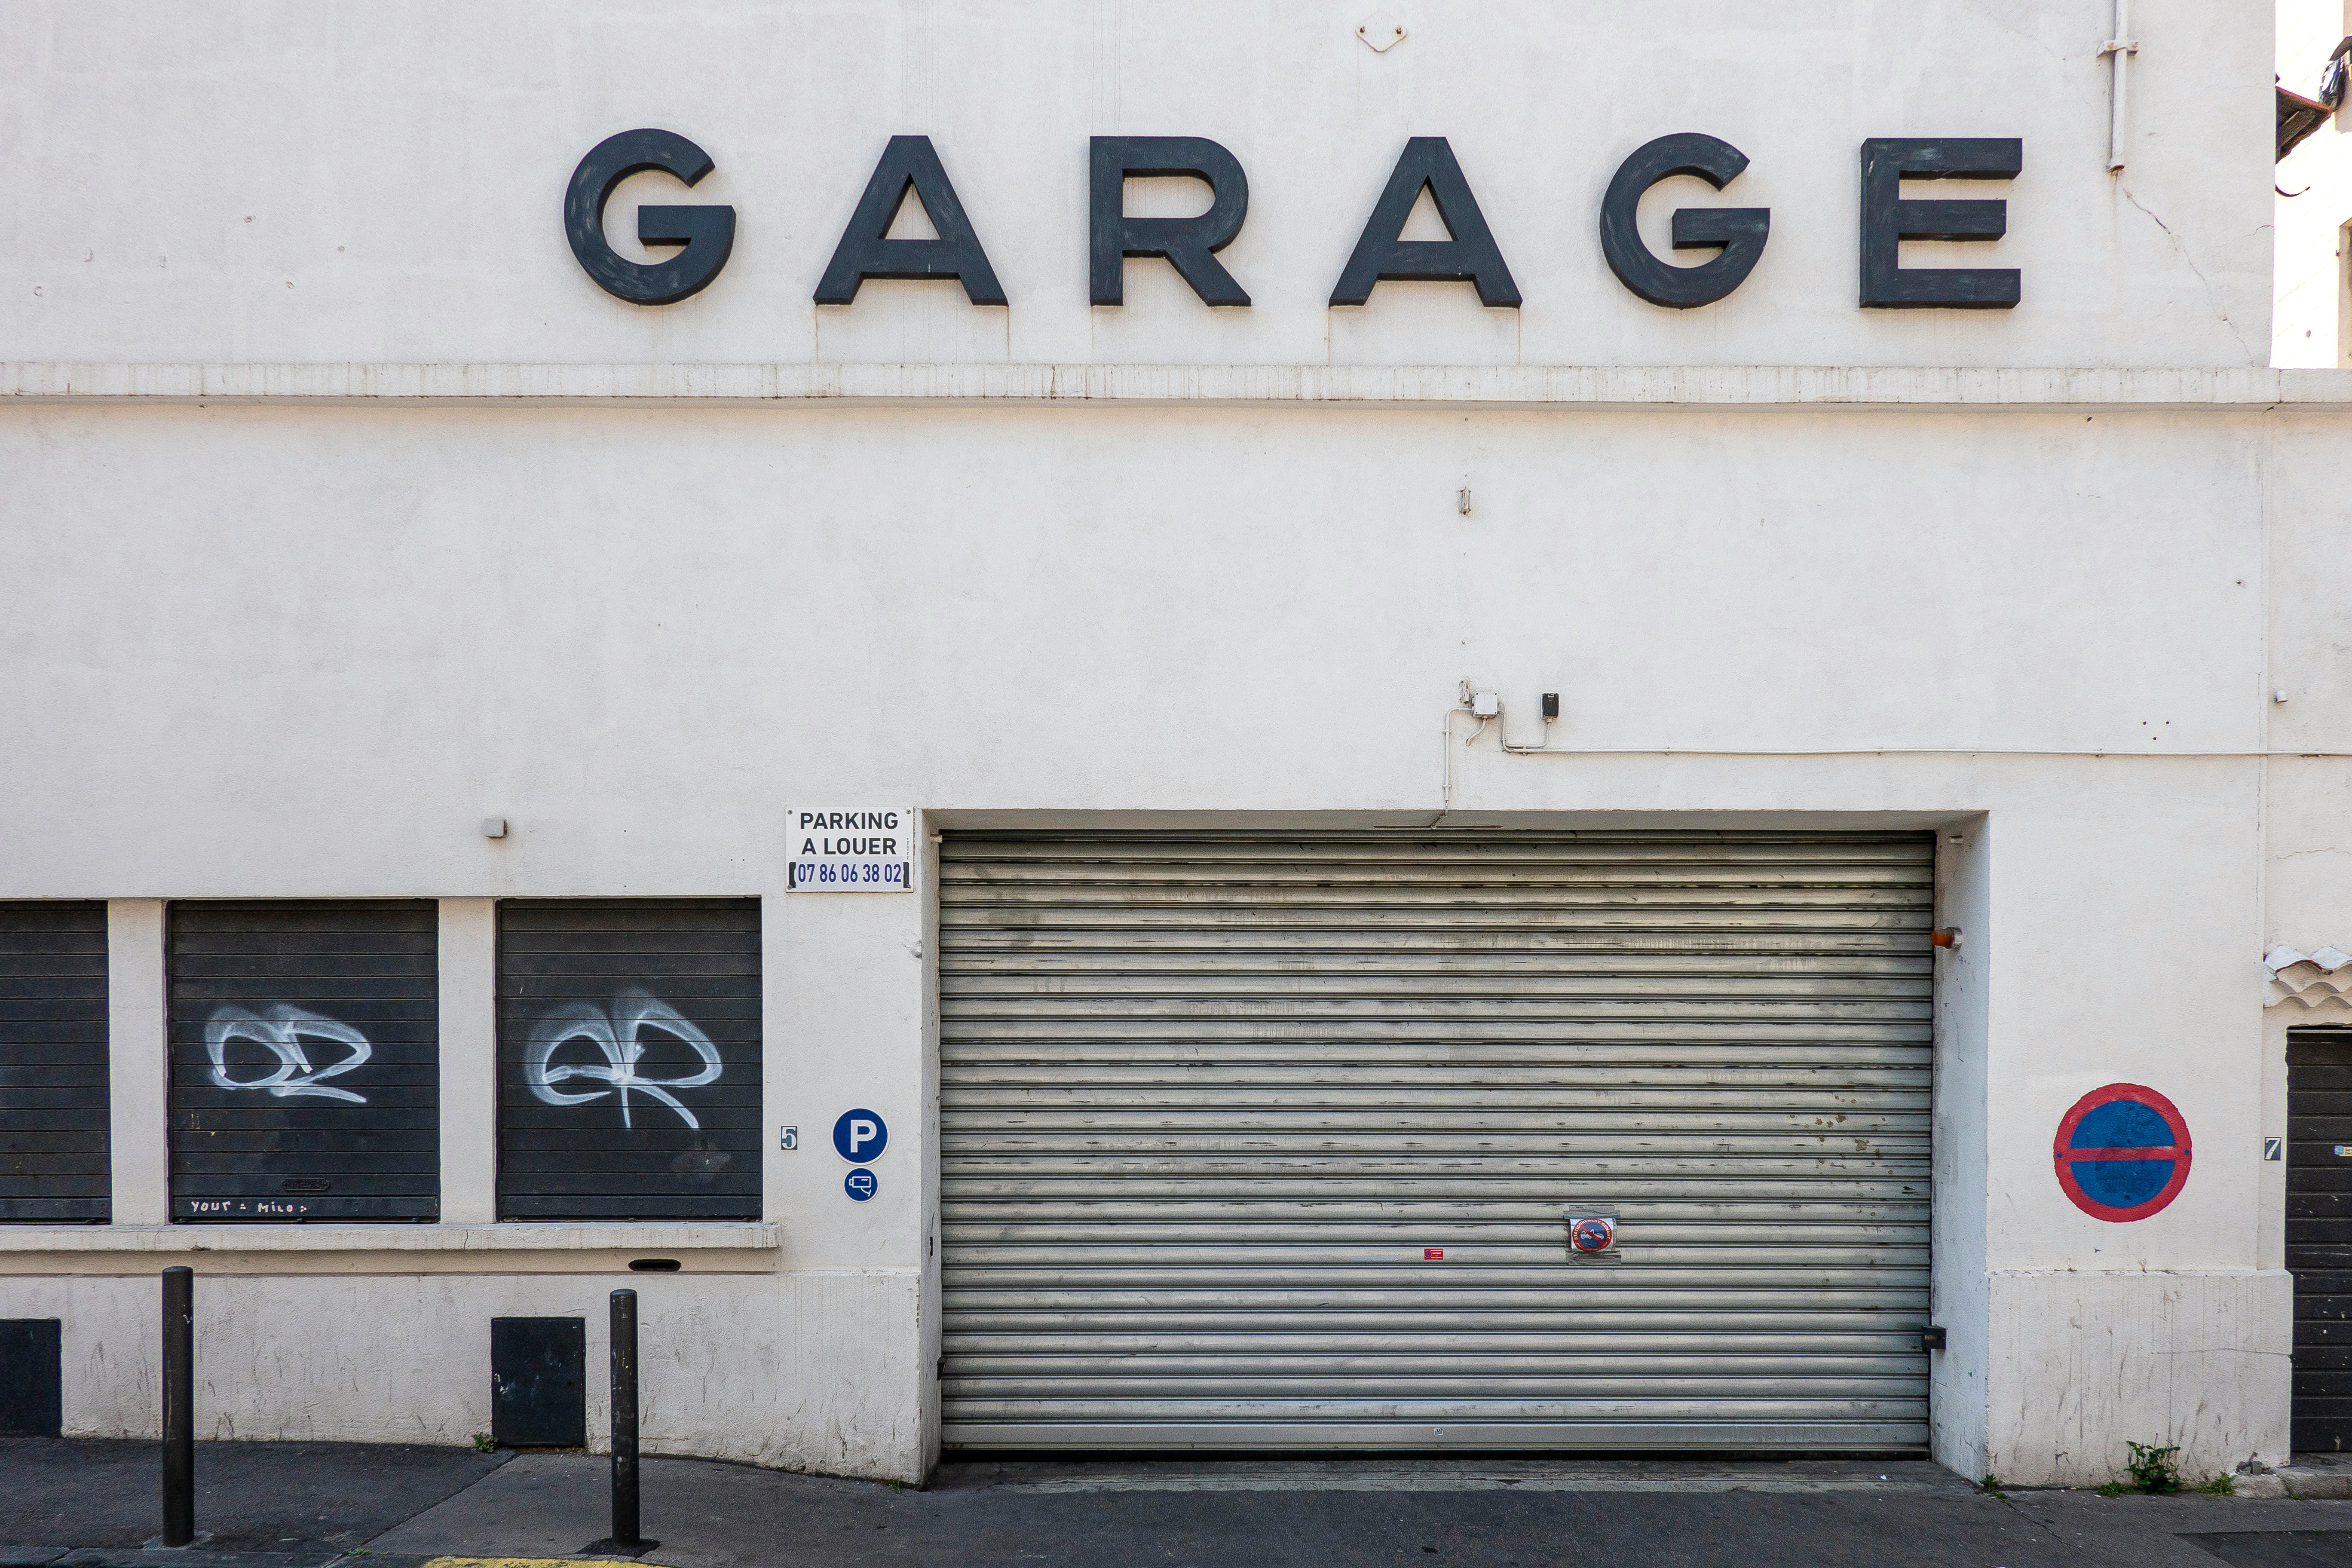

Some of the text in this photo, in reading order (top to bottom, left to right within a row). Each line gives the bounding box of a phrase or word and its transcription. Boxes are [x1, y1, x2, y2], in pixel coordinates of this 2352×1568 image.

[564, 128, 2023, 309] GARAGE
[800, 812, 898, 829] PARKING
[801, 838, 817, 854] A
[824, 837, 896, 855] LOUER
[798, 864, 901, 882] 07 86 06 38 02
[781, 1127, 797, 1149] 5
[850, 1119, 877, 1153] P
[2265, 1137, 2281, 1160] 7
[1574, 1219, 1601, 1240] STATIONNEMENT
